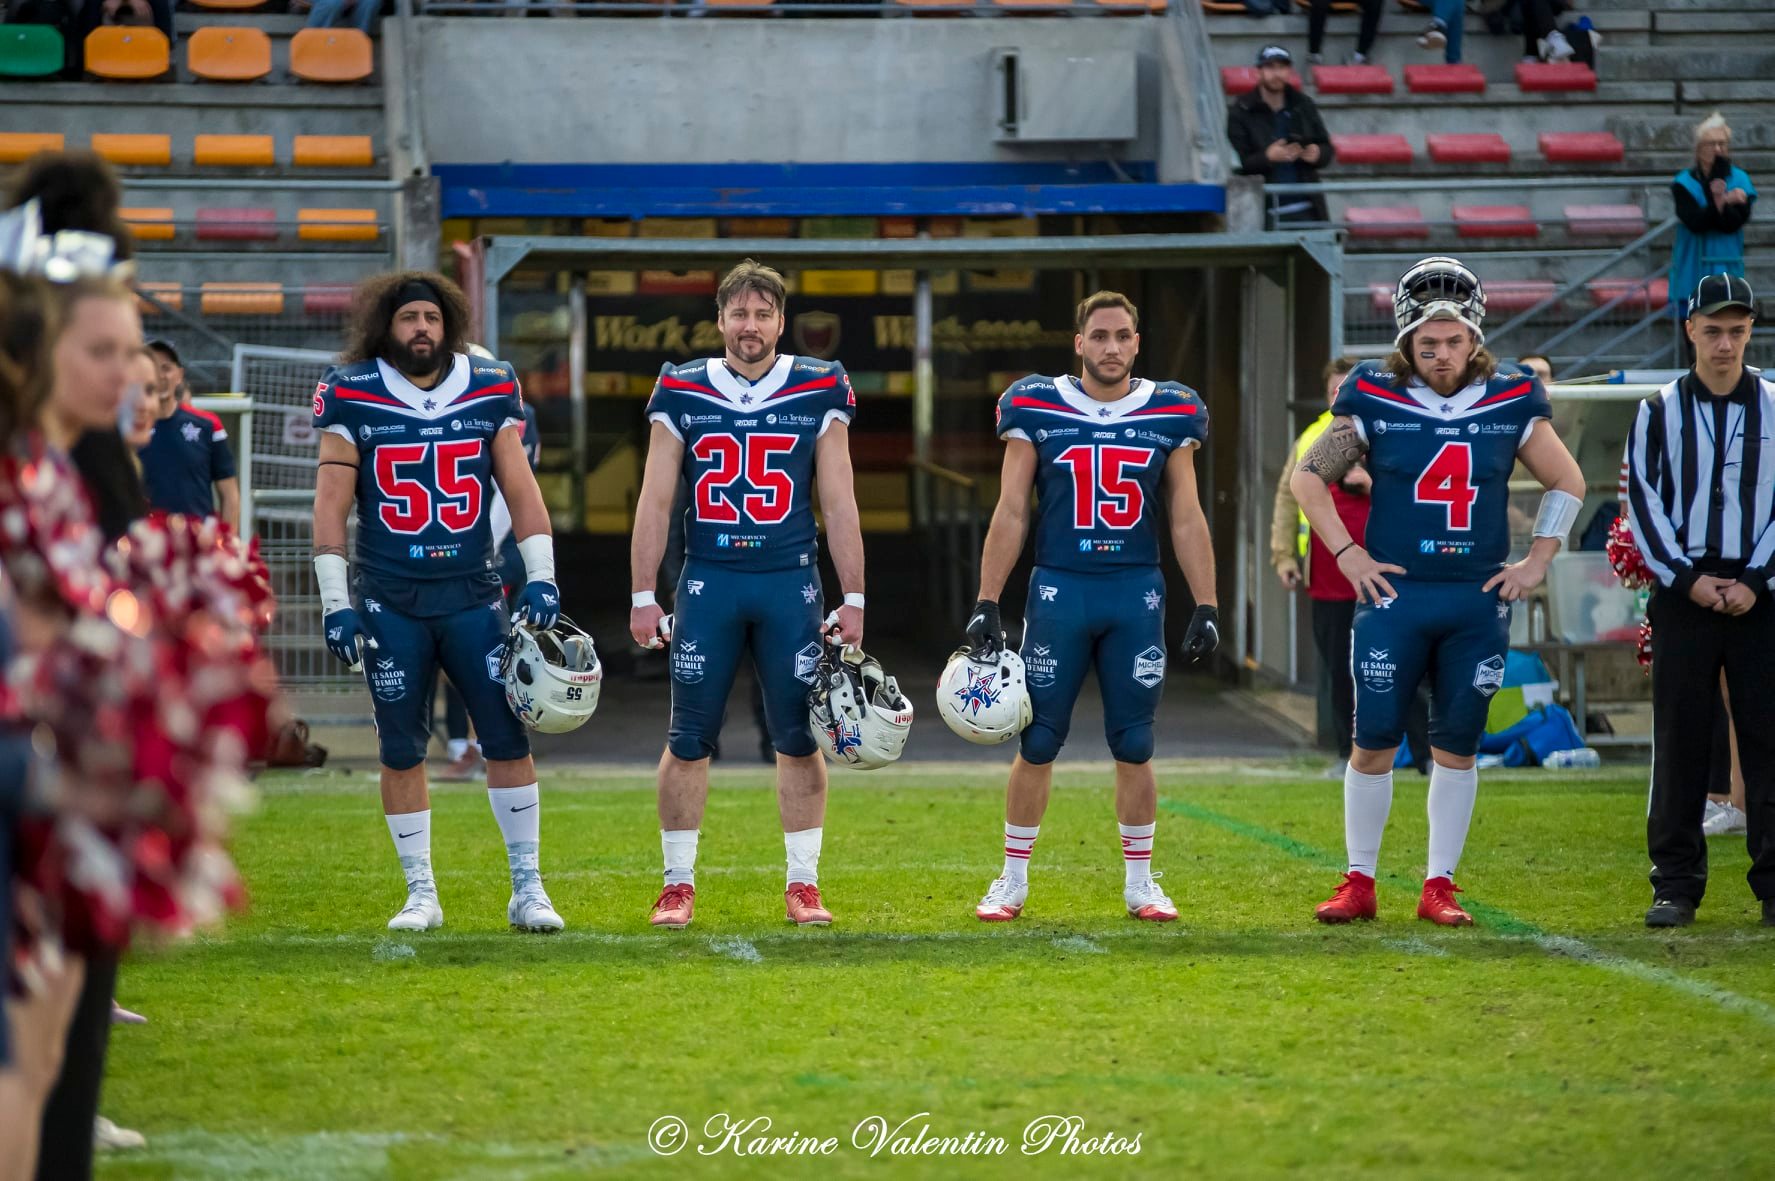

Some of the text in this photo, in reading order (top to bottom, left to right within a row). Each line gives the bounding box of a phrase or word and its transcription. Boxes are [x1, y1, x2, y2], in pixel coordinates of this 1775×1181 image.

[350, 372, 380, 382] acqua
[372, 424, 406, 432] TURQUOISE
[1492, 423, 1518, 431] Tentation
[1092, 431, 1118, 439] RIDGE
[692, 432, 800, 525] 25
[374, 437, 485, 535] 55
[1052, 444, 1156, 530] 15
[1414, 441, 1480, 531] 4
[680, 653, 705, 662] SALON
[1033, 657, 1058, 667] SALON
[1370, 661, 1397, 671] SALON
[379, 670, 405, 679] SALON
[566, 686, 582, 700] 55
